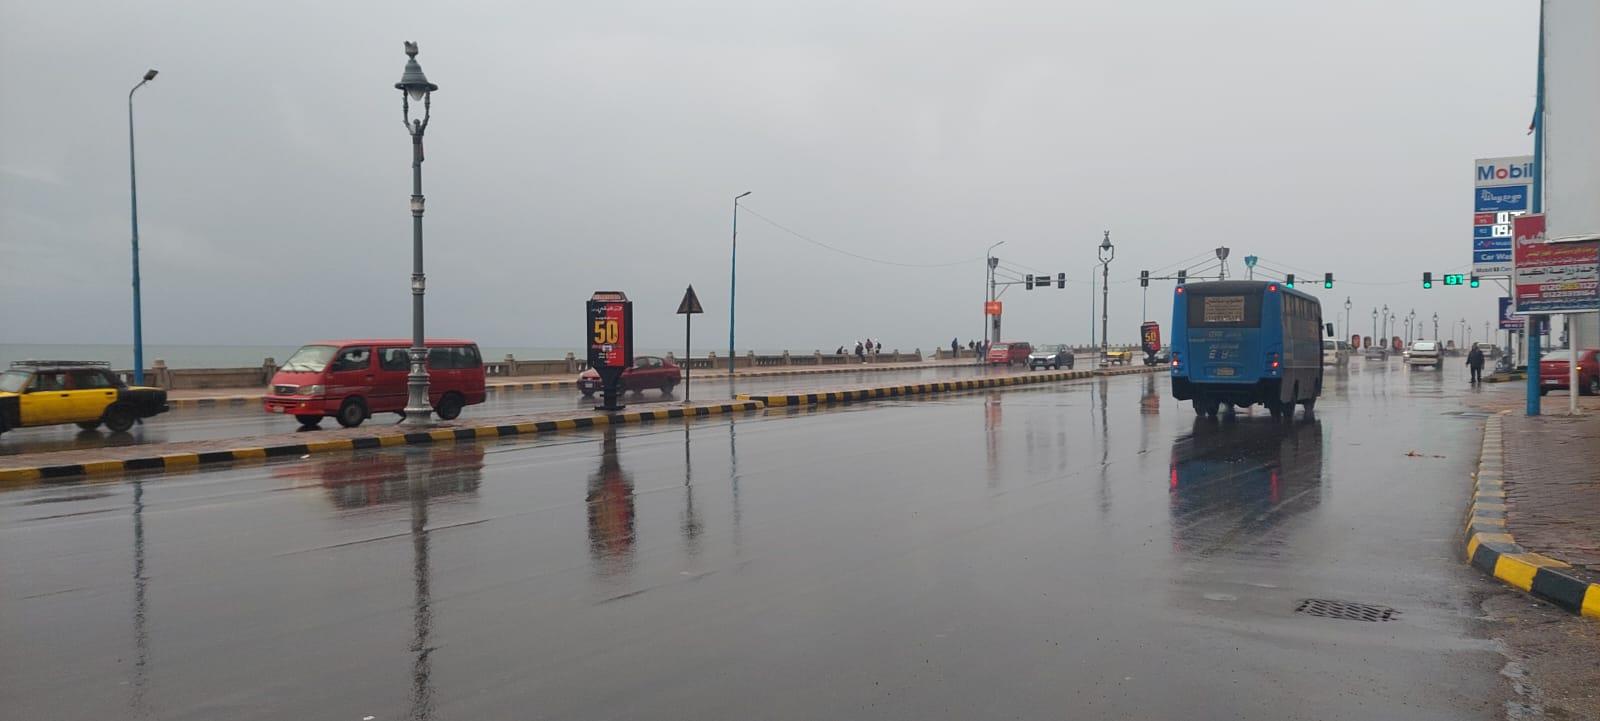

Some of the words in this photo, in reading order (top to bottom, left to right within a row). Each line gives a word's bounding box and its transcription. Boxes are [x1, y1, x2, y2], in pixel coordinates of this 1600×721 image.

[1478, 163, 1532, 181] Mobil
[1492, 225, 1512, 237] 09.
[595, 320, 618, 344] 50
